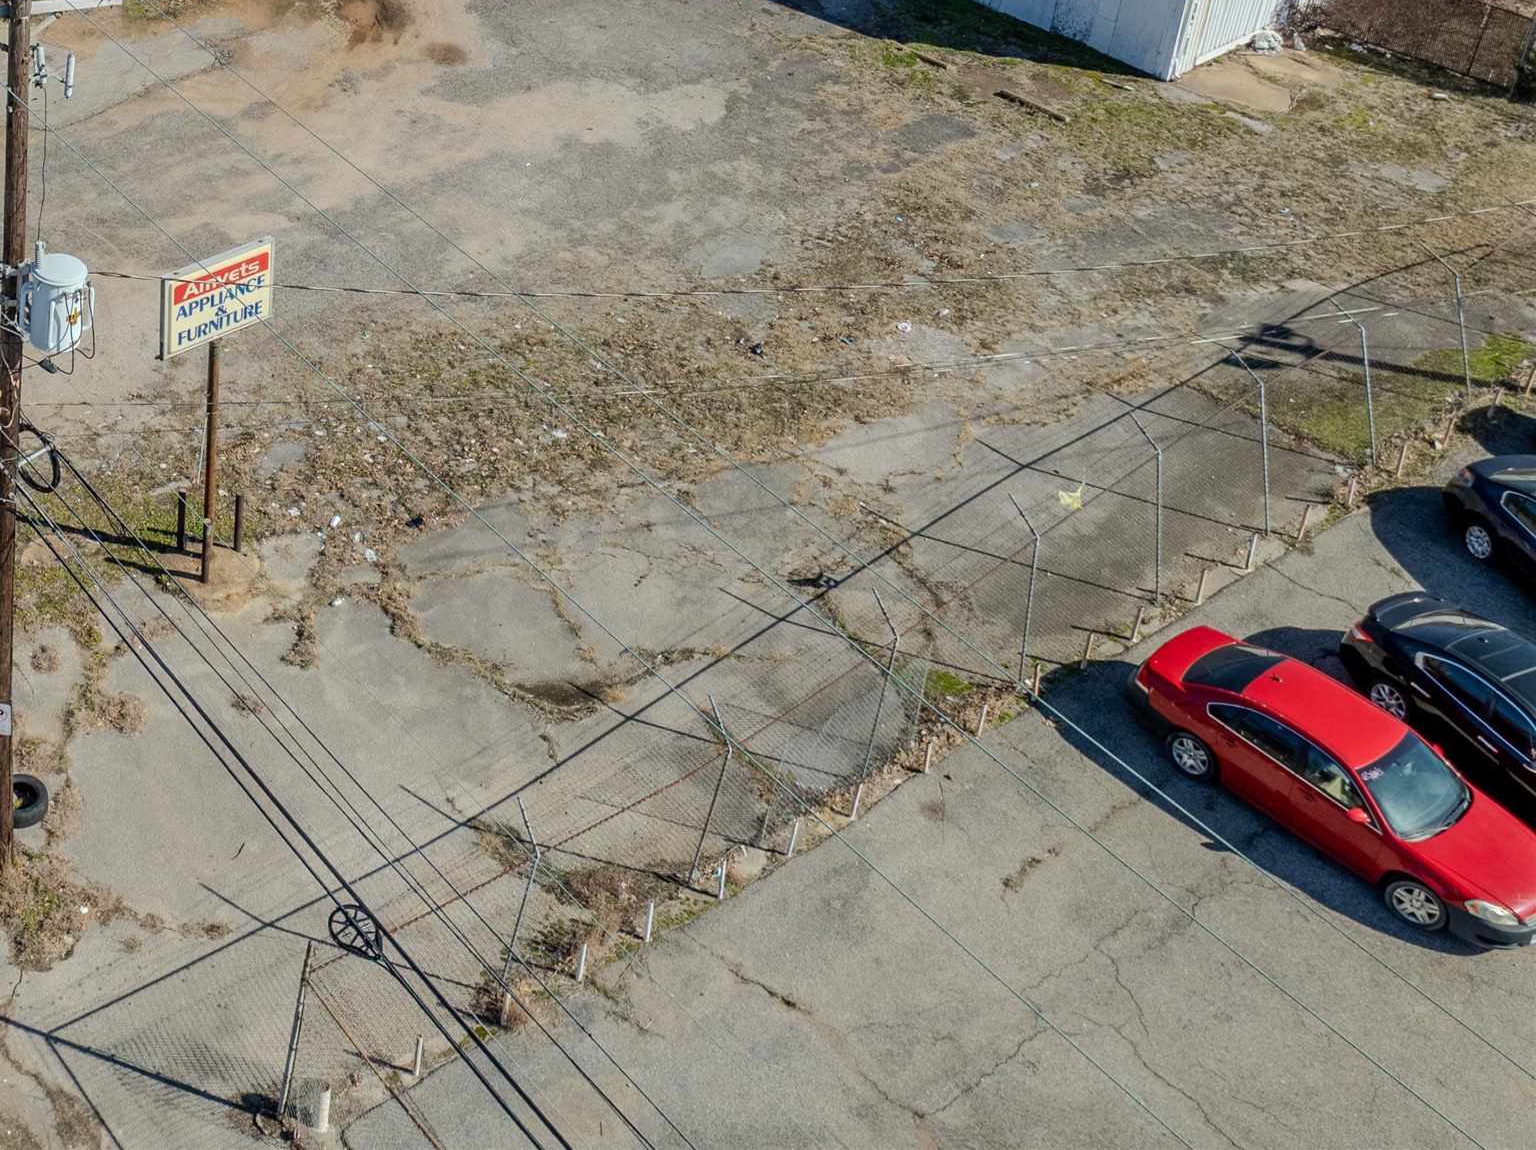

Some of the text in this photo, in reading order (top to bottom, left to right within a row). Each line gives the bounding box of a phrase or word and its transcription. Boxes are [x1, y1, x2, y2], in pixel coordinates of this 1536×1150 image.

[176, 274, 265, 321] APPLIANCE
[183, 261, 260, 300] Amvets
[178, 300, 263, 345] FURNITURE
[215, 305, 228, 317] &
